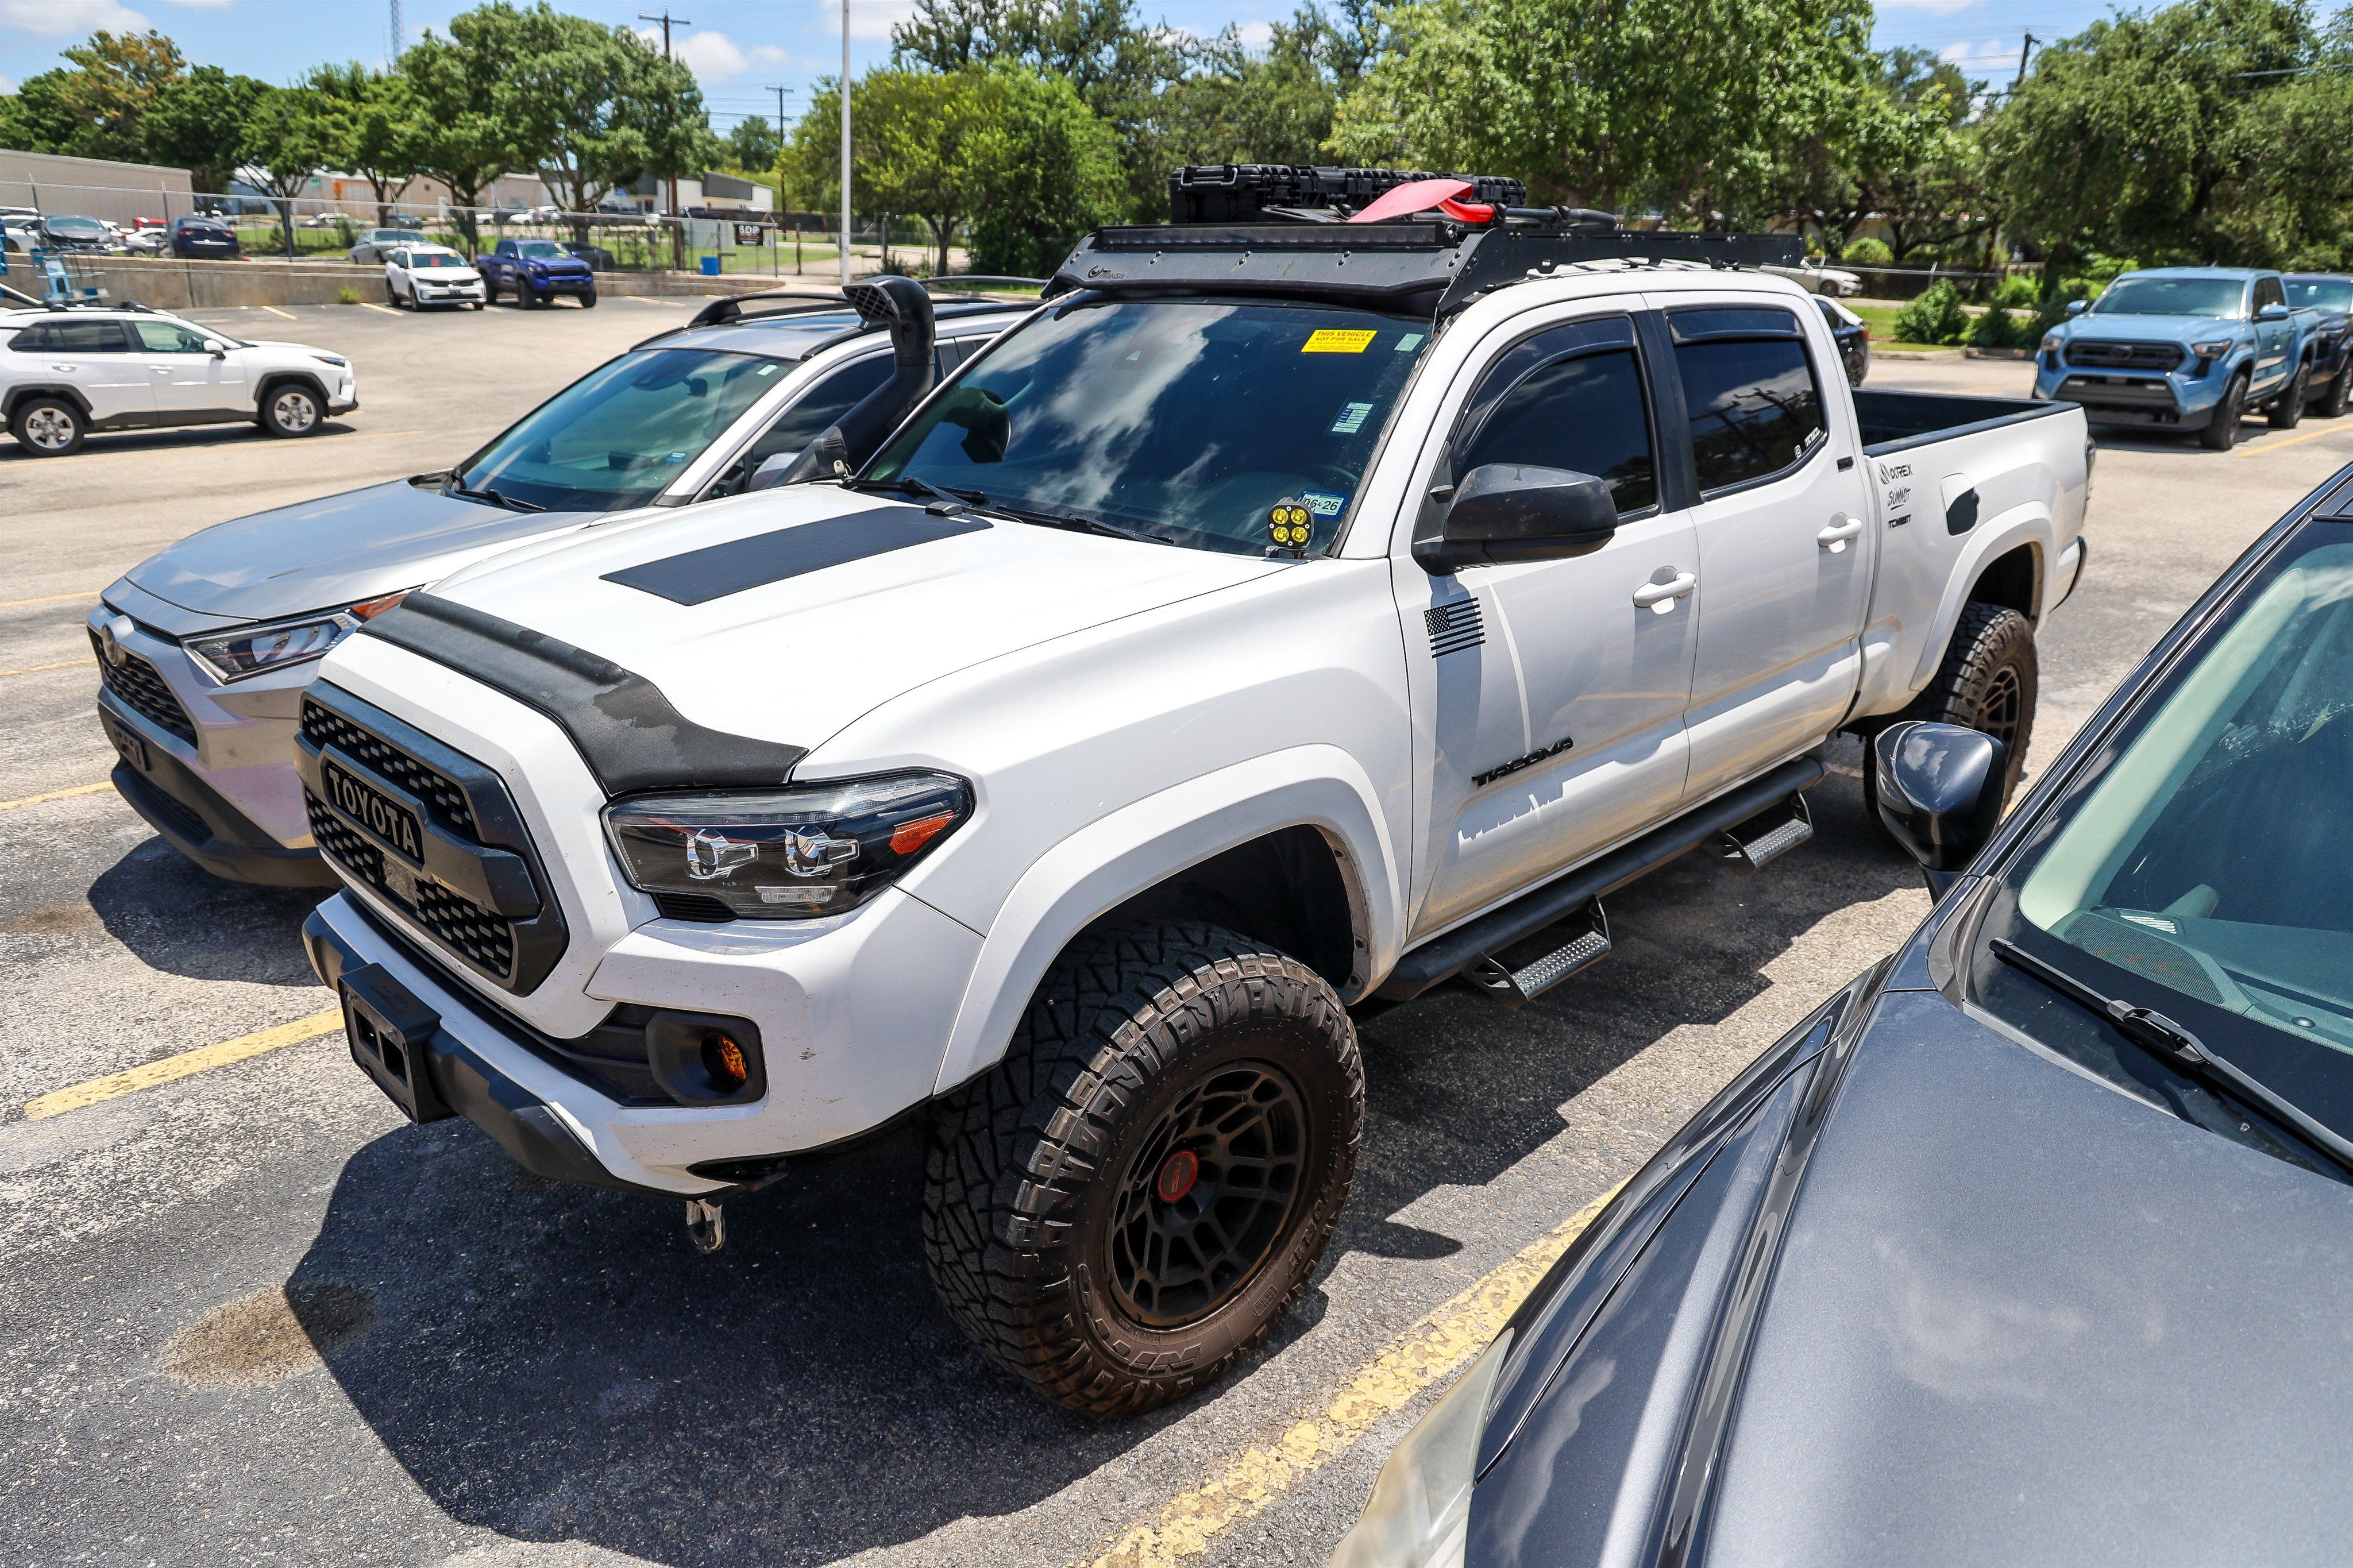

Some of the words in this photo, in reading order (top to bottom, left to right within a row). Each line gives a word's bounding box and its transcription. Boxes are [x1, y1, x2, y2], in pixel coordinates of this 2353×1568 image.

[1471, 736, 1574, 787] TACOMA
[329, 768, 419, 858] TOYOTA
[1171, 1157, 1182, 1193] TRD
